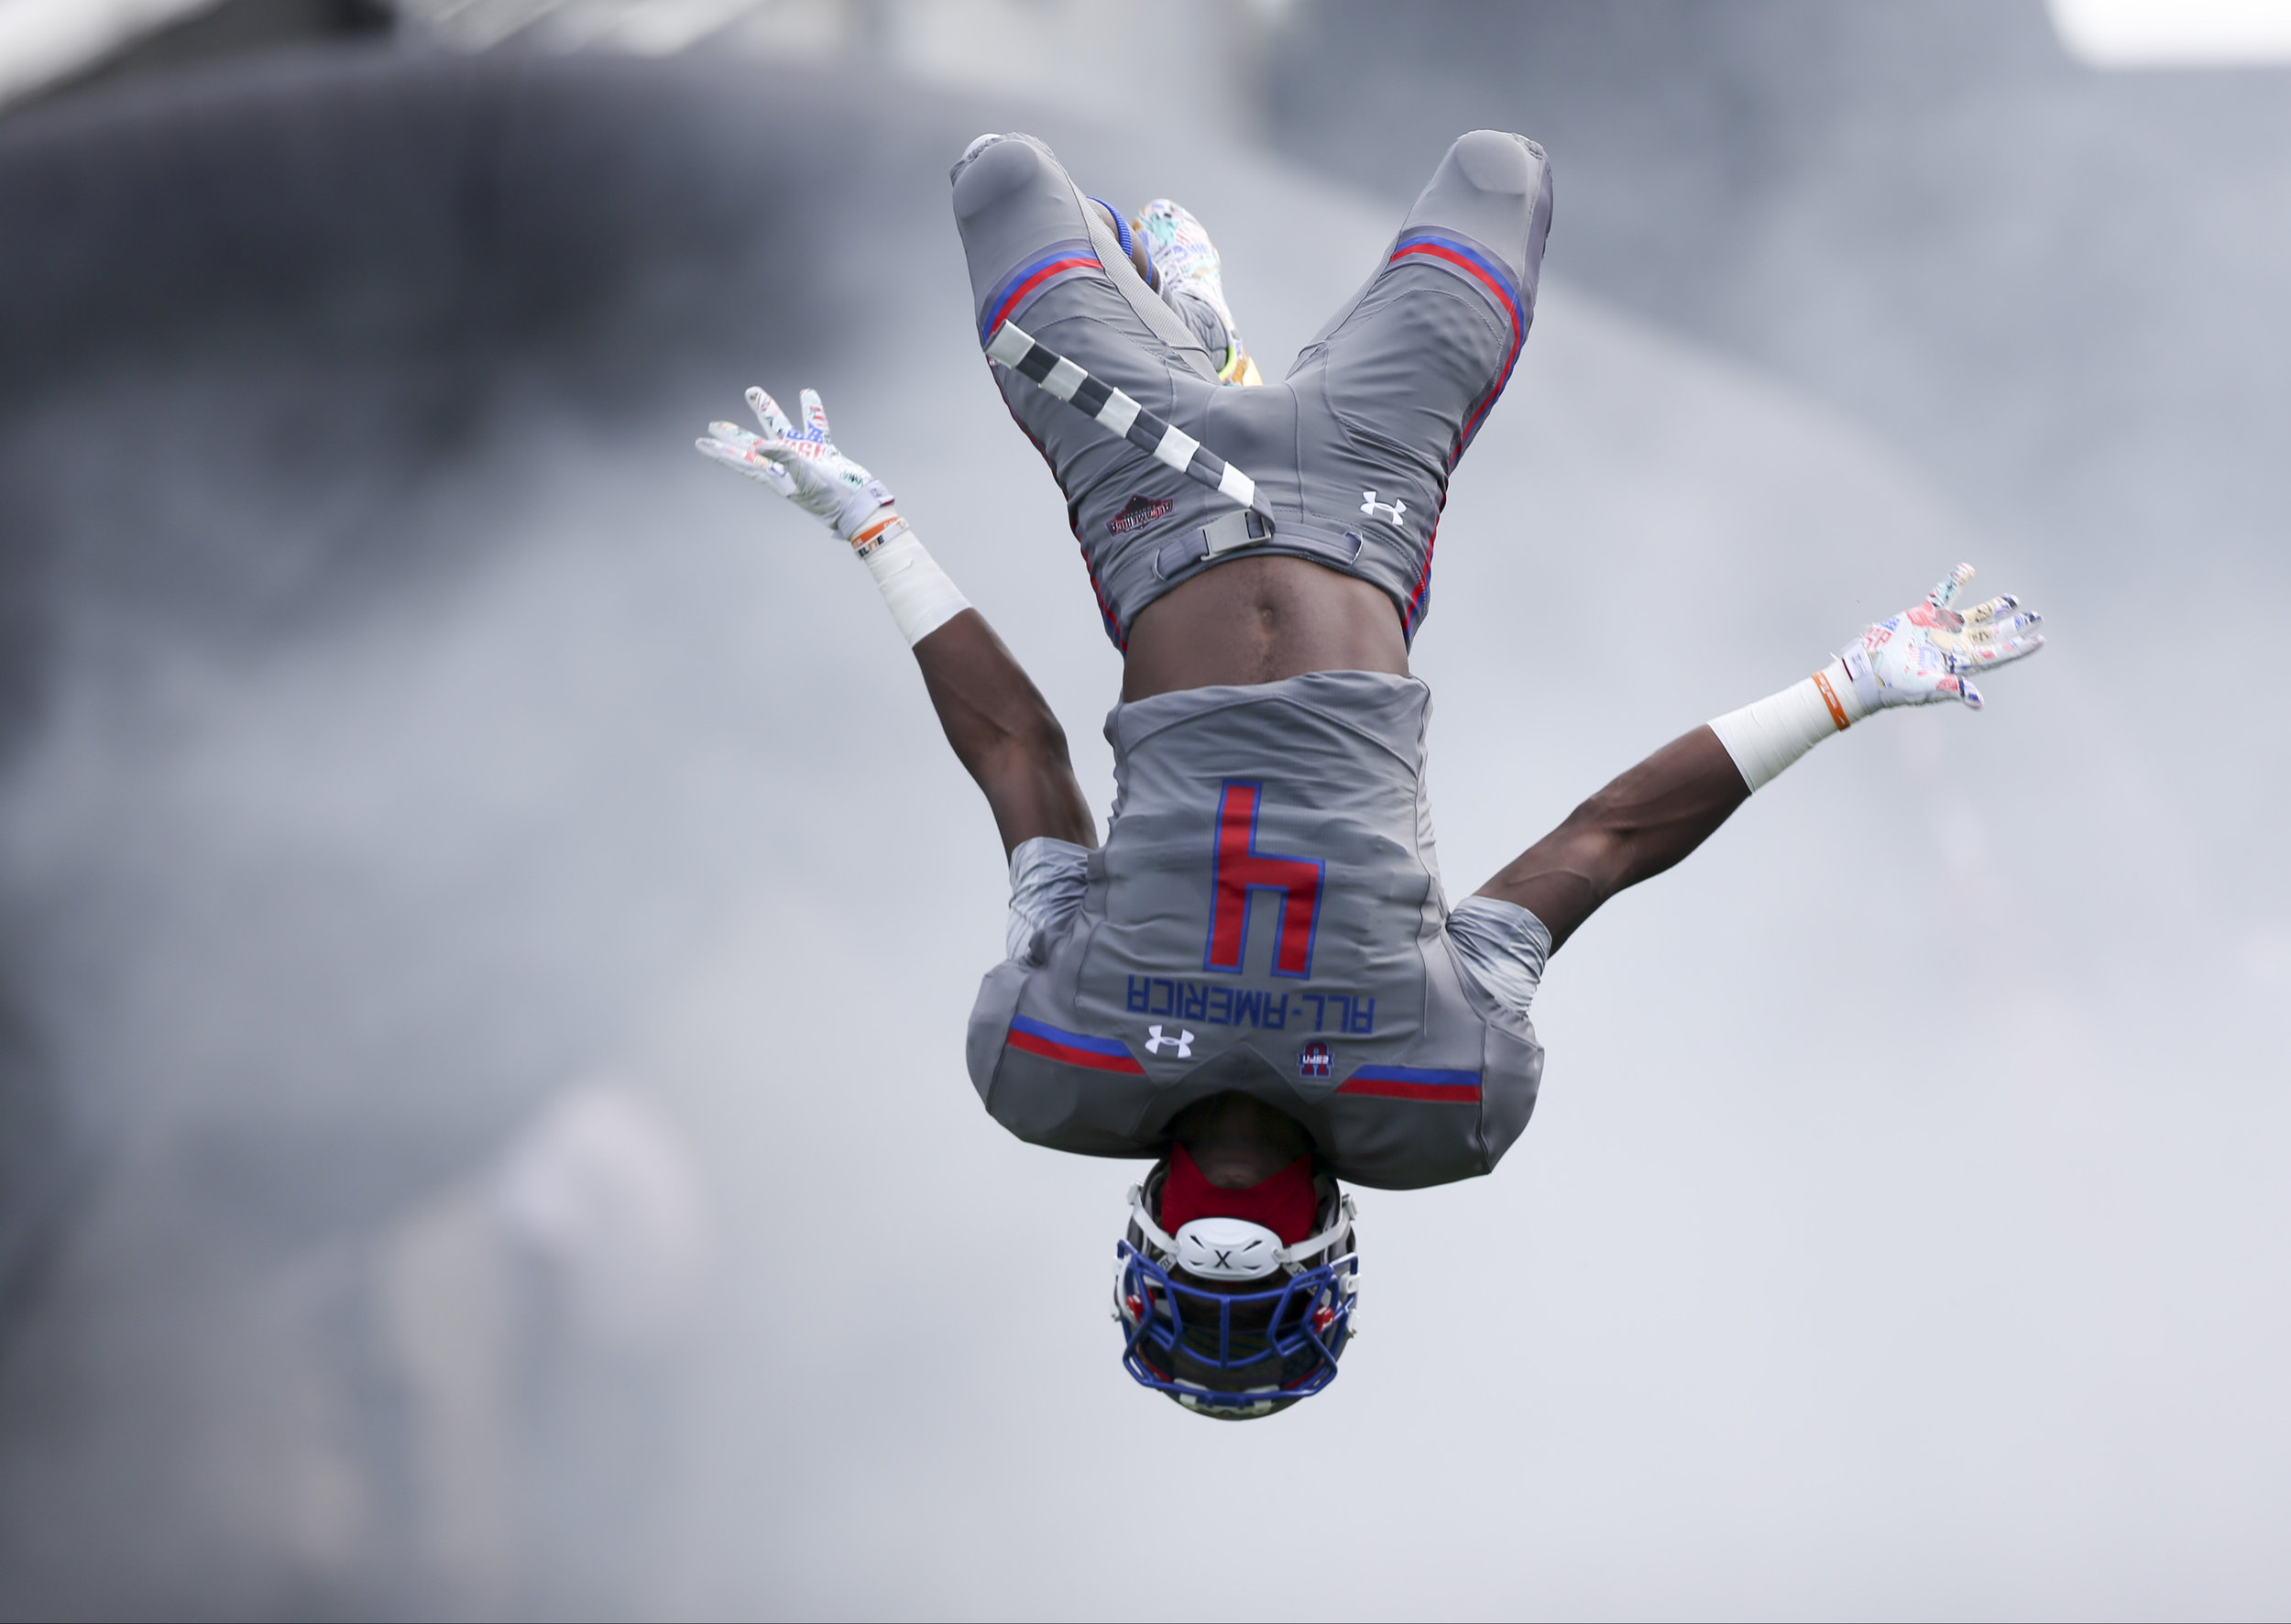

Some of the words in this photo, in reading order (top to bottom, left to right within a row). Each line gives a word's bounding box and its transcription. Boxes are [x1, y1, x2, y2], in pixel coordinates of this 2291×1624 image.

[1202, 778, 1326, 980] 4
[1124, 973, 1377, 1035] ALL-AMERICA
[1302, 1055, 1330, 1065] ESPN
[1213, 1249, 1232, 1270] X
